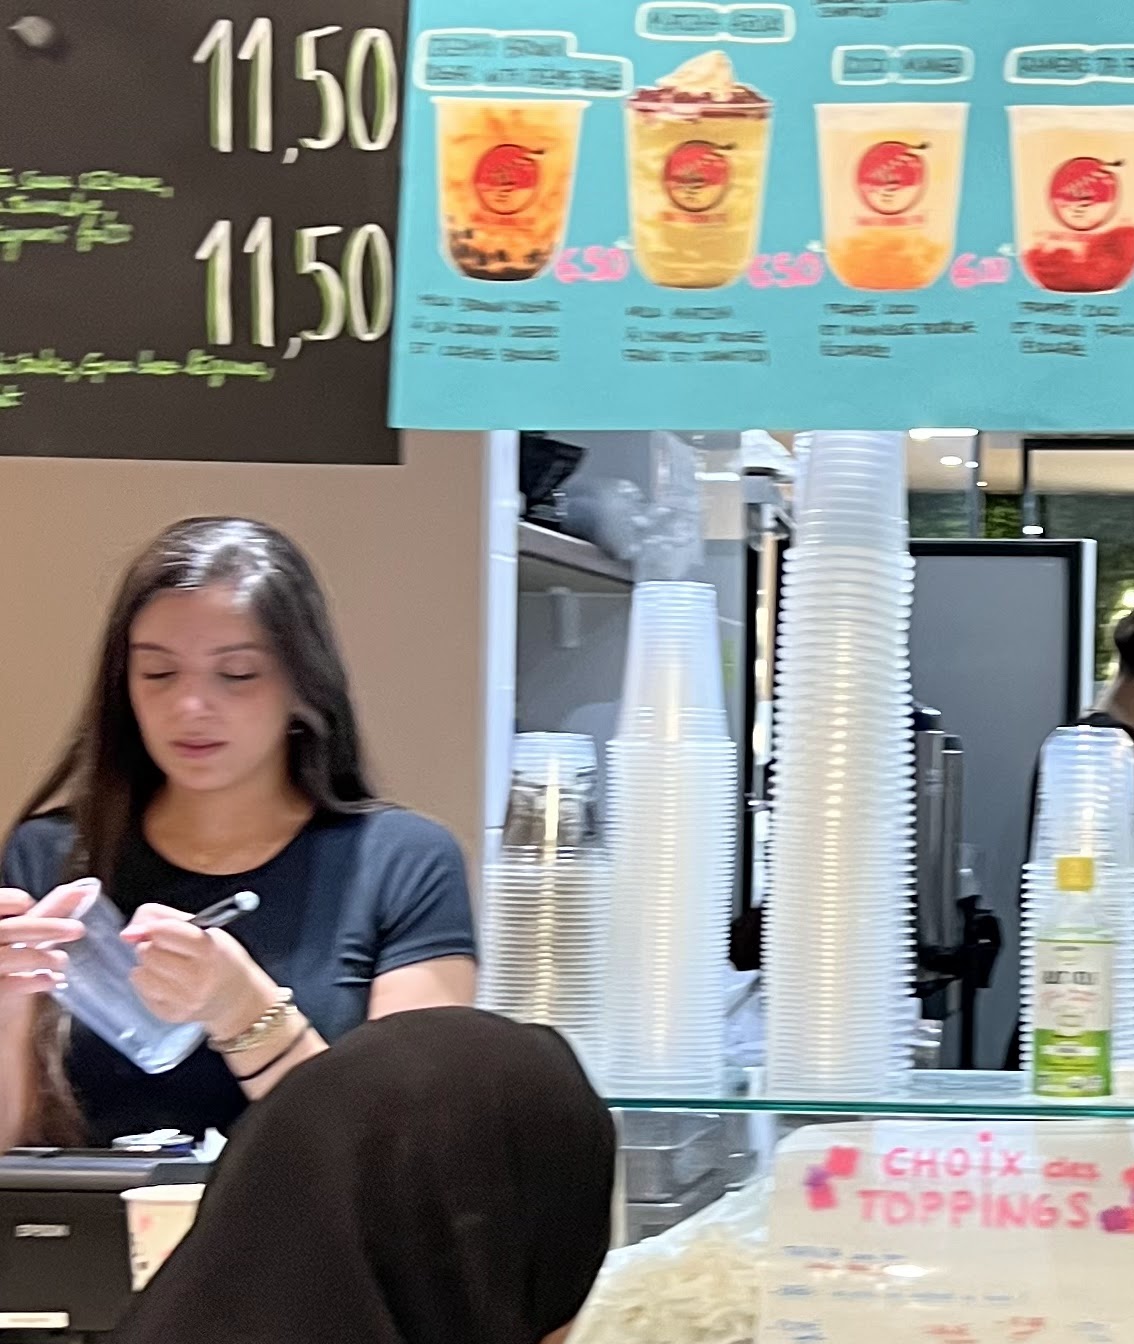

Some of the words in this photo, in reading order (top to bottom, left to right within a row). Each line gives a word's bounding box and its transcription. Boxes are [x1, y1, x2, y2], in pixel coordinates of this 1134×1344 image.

[192, 17, 398, 164] 11,50
[194, 216, 393, 360] 11,50
[857, 1188, 1091, 1229] TOPPINGS
